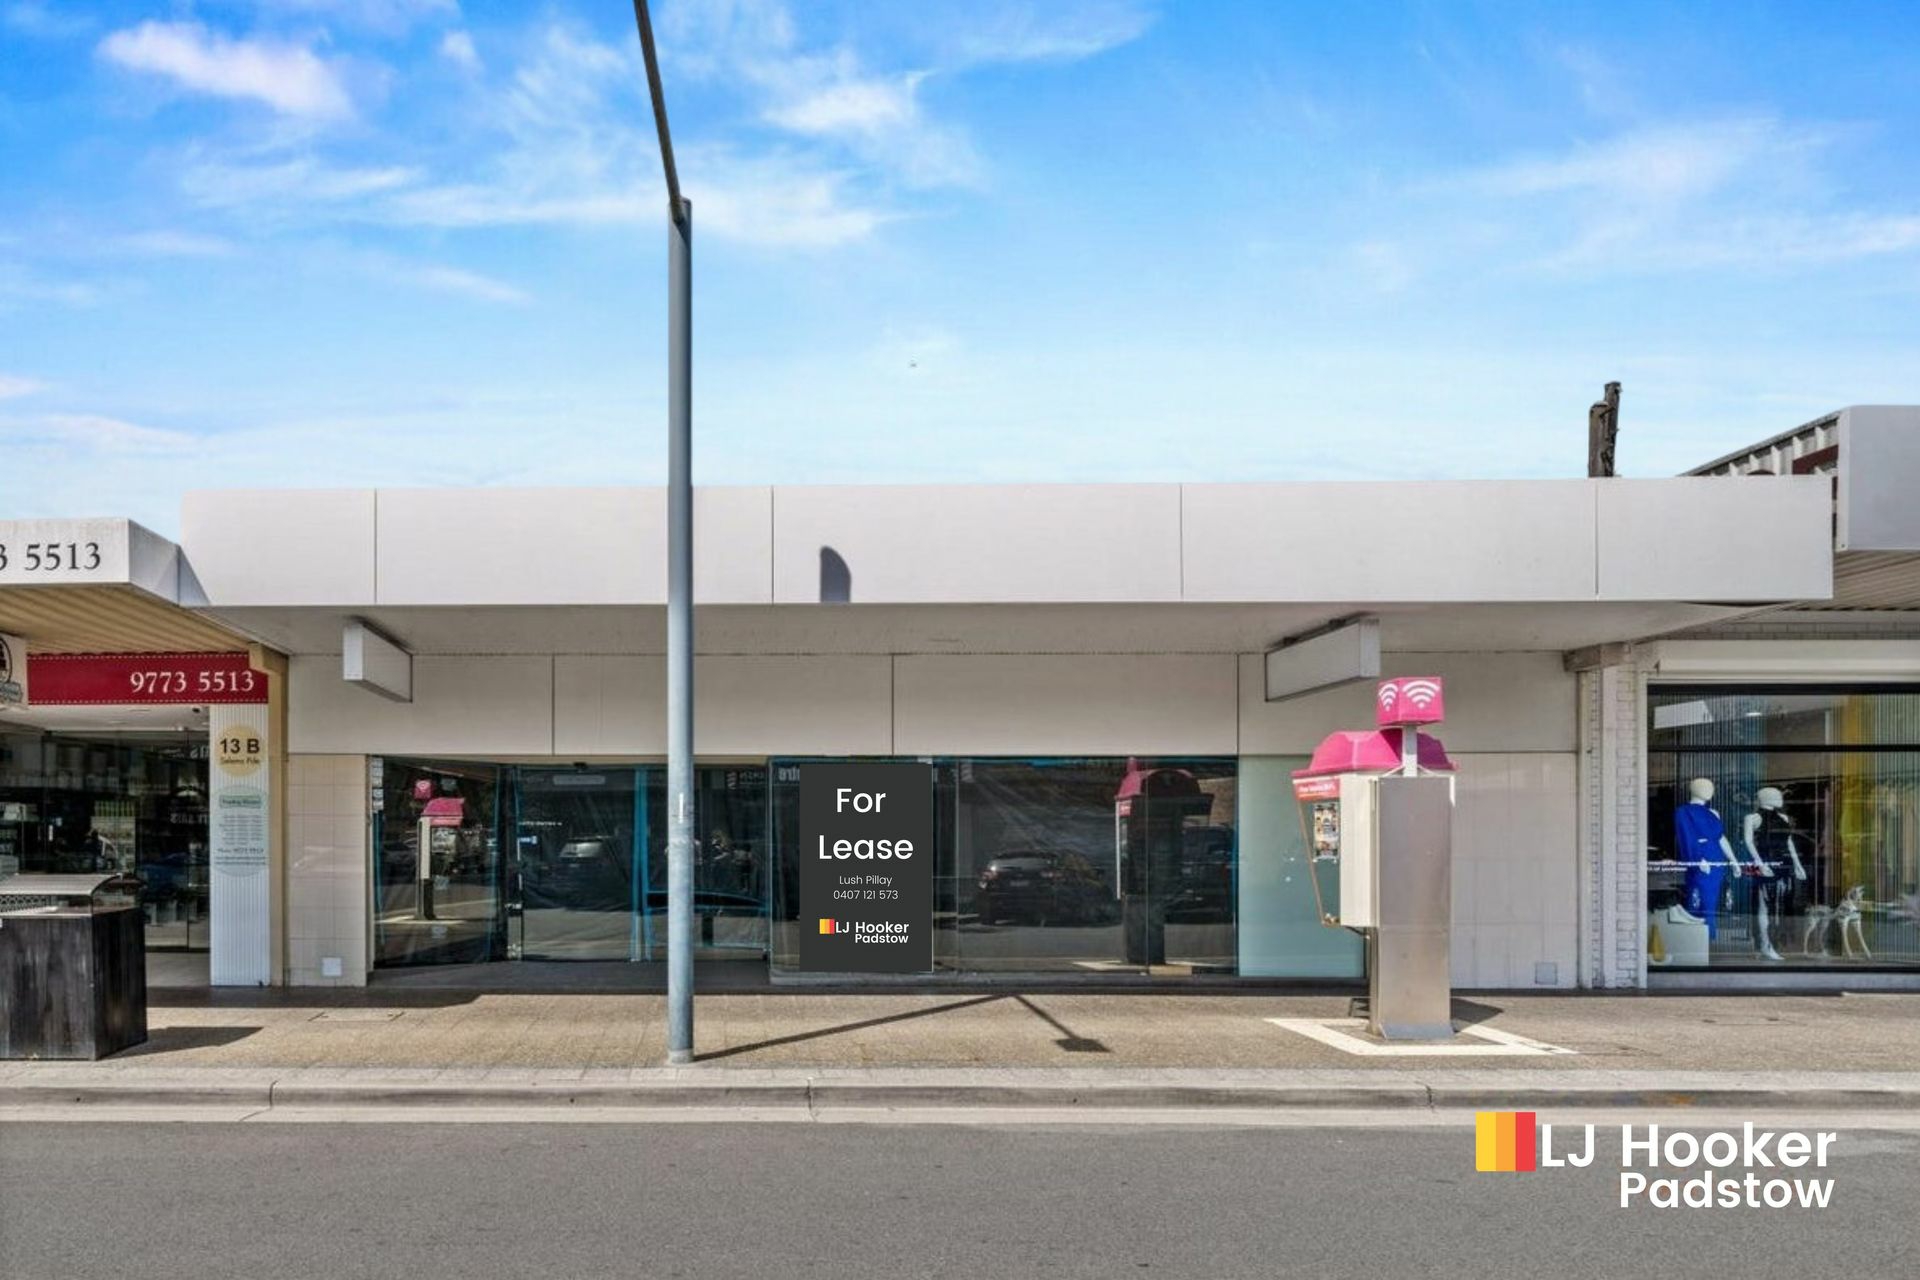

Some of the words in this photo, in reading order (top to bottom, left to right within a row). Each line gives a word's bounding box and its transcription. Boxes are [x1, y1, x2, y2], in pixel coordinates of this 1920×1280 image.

[25, 542, 101, 571] 5513
[130, 671, 187, 693] 9773
[199, 671, 255, 692] 5513
[220, 738, 241, 754] 13
[247, 738, 260, 754] B
[836, 788, 887, 813] For
[819, 835, 914, 860] Lease
[839, 875, 863, 885] Lush
[866, 875, 893, 887] Pillay
[833, 890, 860, 900] 0407
[863, 890, 876, 900] 121
[879, 890, 899, 900] 573
[835, 921, 850, 934] LJ
[855, 921, 910, 934] Hooker
[854, 933, 909, 944] Padstow
